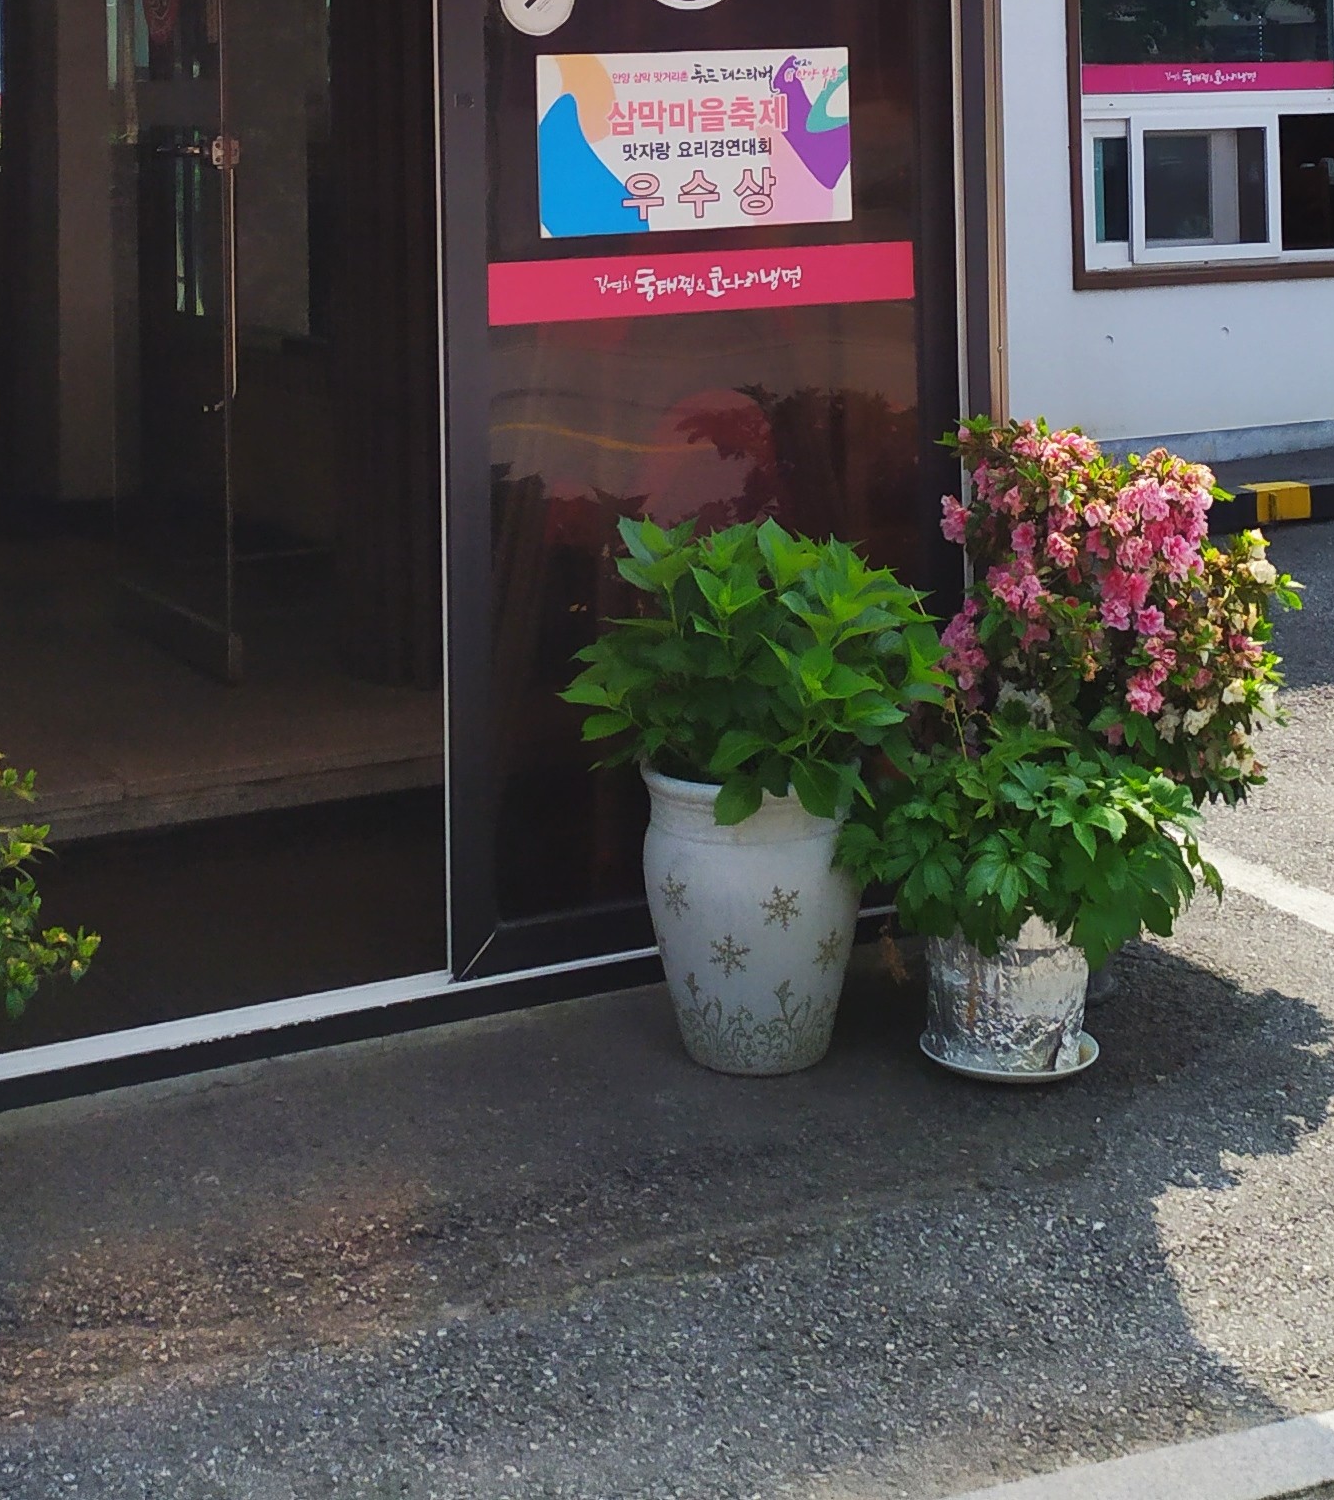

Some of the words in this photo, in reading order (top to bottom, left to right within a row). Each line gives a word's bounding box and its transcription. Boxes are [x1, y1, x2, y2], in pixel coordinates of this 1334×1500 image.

[690, 63, 720, 84] 푸드
[608, 94, 787, 137] 삼막마을축제
[622, 141, 671, 162] 맛자랑
[677, 136, 772, 160] 요리경연대회
